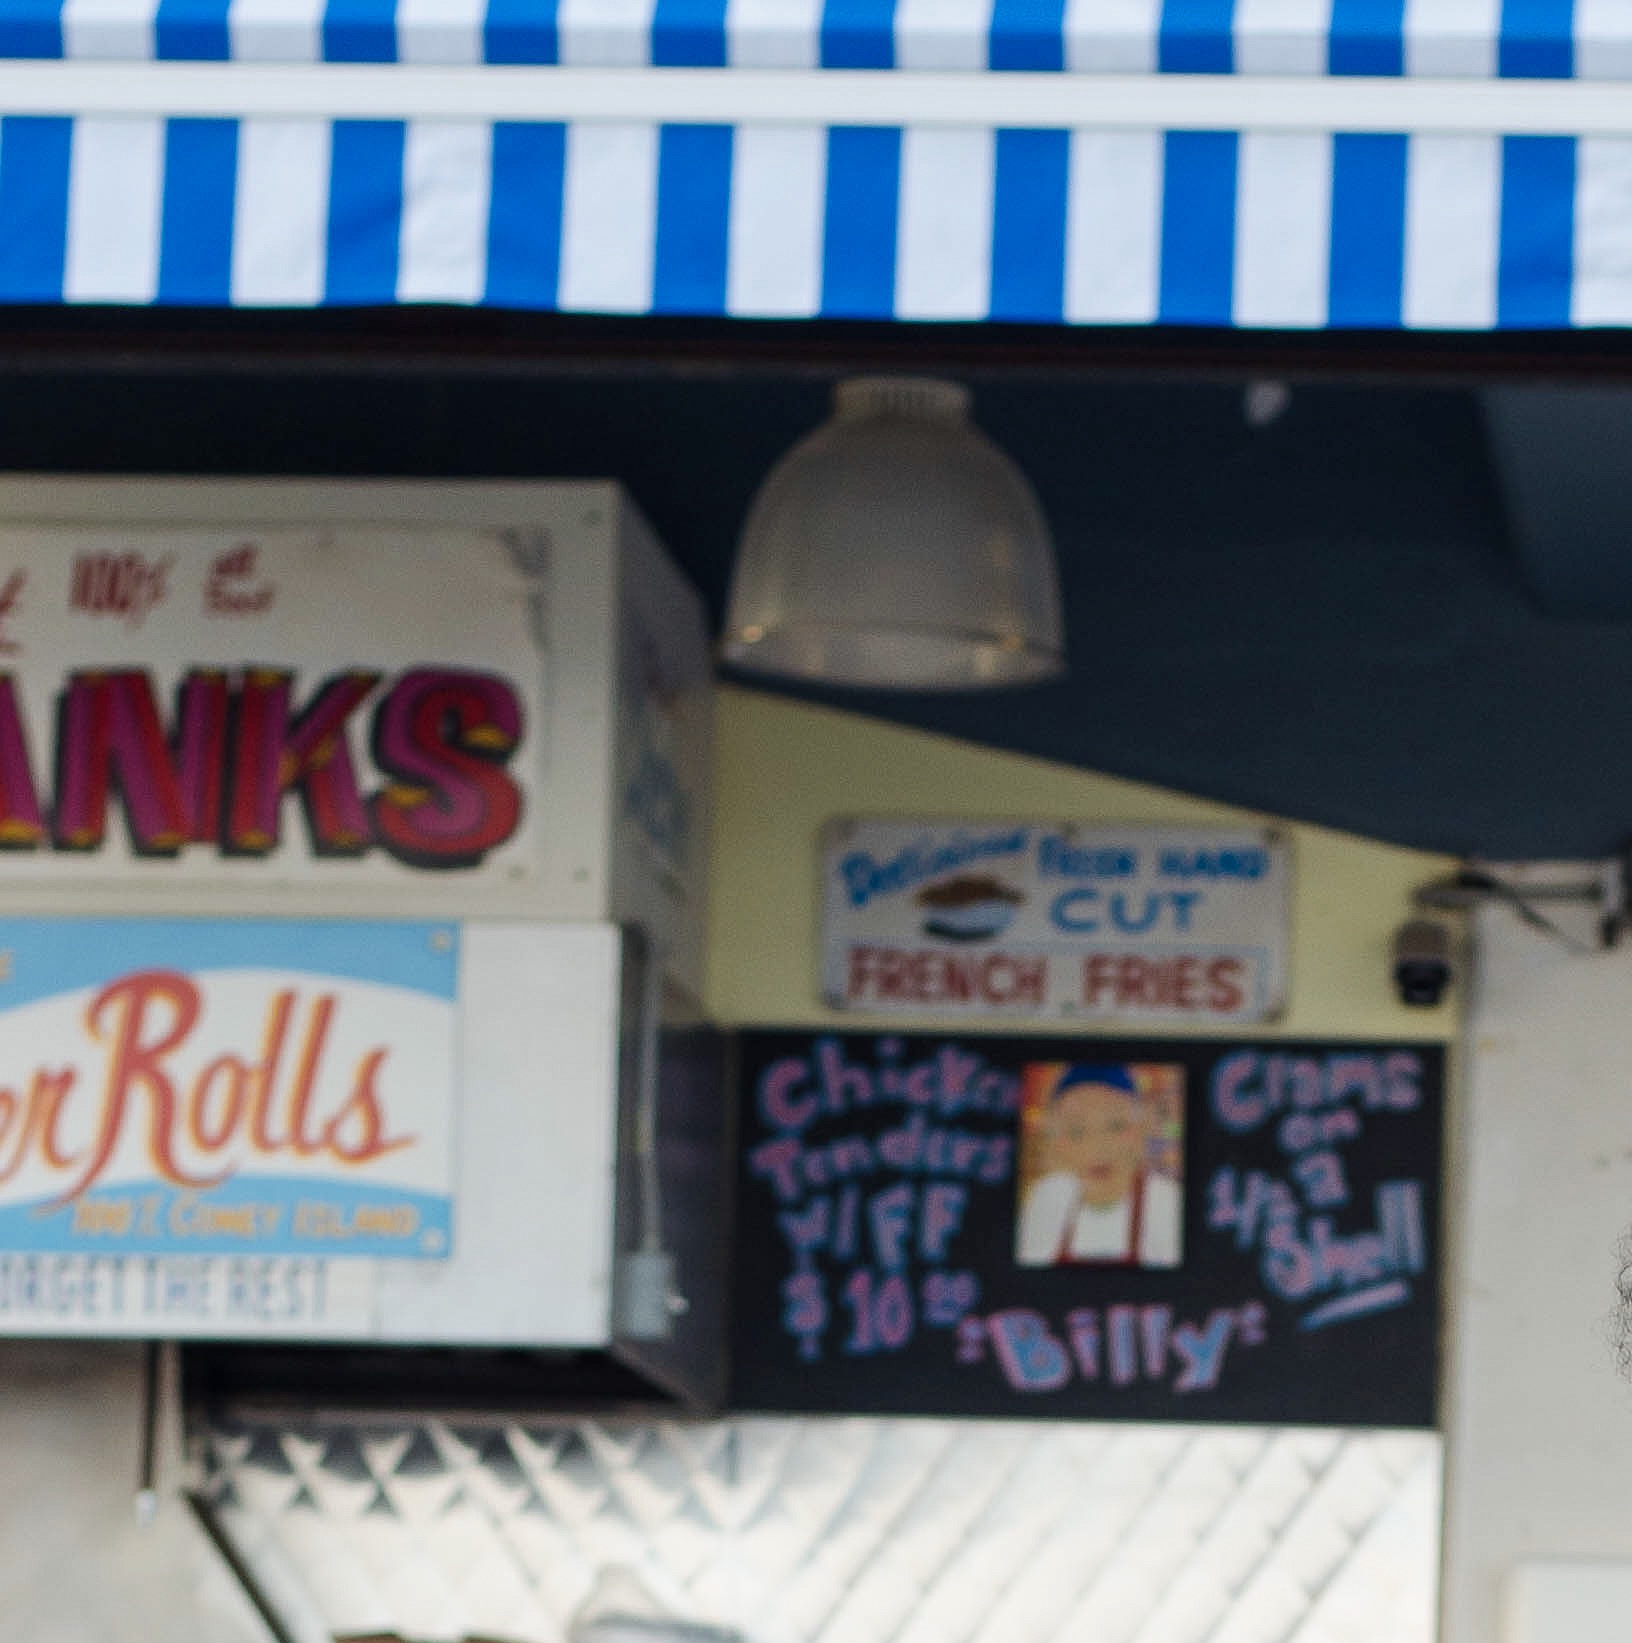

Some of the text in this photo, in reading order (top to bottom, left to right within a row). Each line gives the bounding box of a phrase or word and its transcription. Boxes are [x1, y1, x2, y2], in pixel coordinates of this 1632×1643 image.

[1050, 888, 1206, 933] CUT
[847, 943, 1248, 1012] FRENCH FRIES
[33, 966, 419, 1215] Rolls
[292, 1202, 420, 1241] ISLAND
[1263, 1180, 1425, 1295] Shell
[142, 1257, 213, 1319] THE
[227, 1258, 330, 1321] REST
